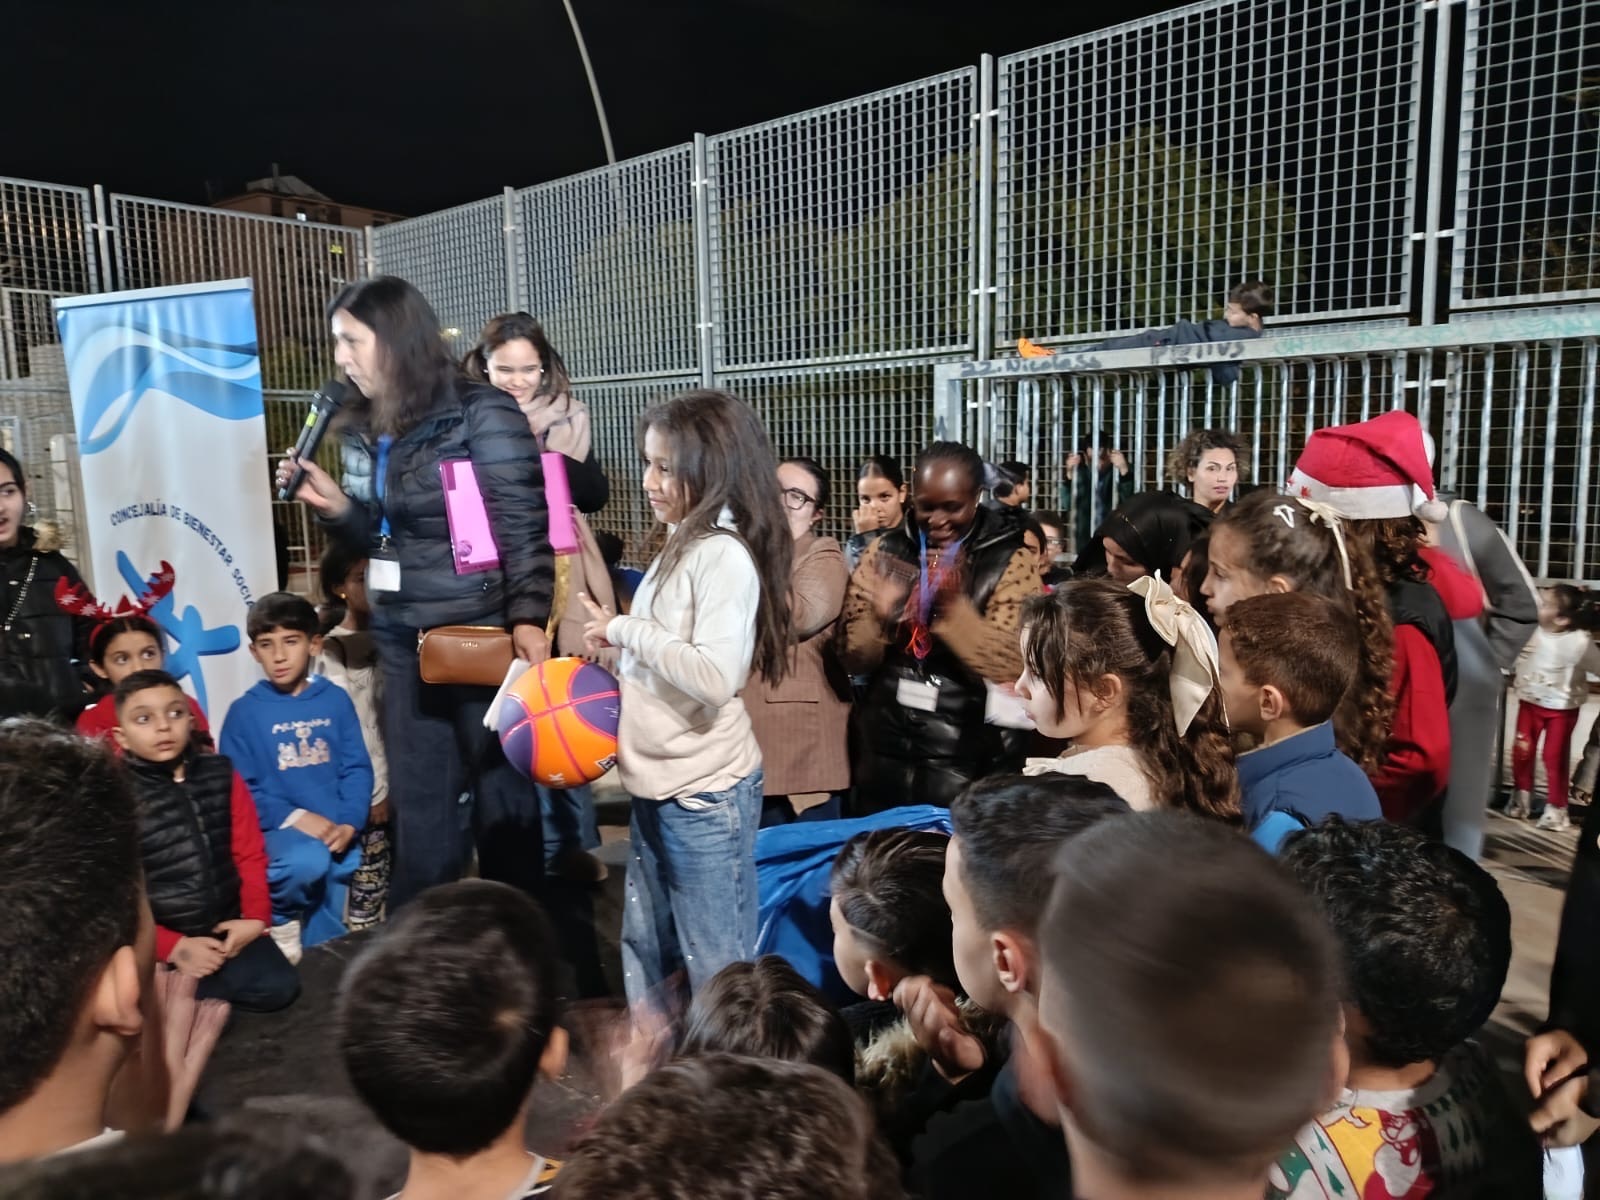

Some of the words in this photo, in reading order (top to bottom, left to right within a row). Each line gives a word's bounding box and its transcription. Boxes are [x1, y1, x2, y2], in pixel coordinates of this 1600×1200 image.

[110, 499, 167, 526] CONCEJALÍA
[169, 505, 182, 521] DE
[183, 512, 234, 567] BIENESTAR
